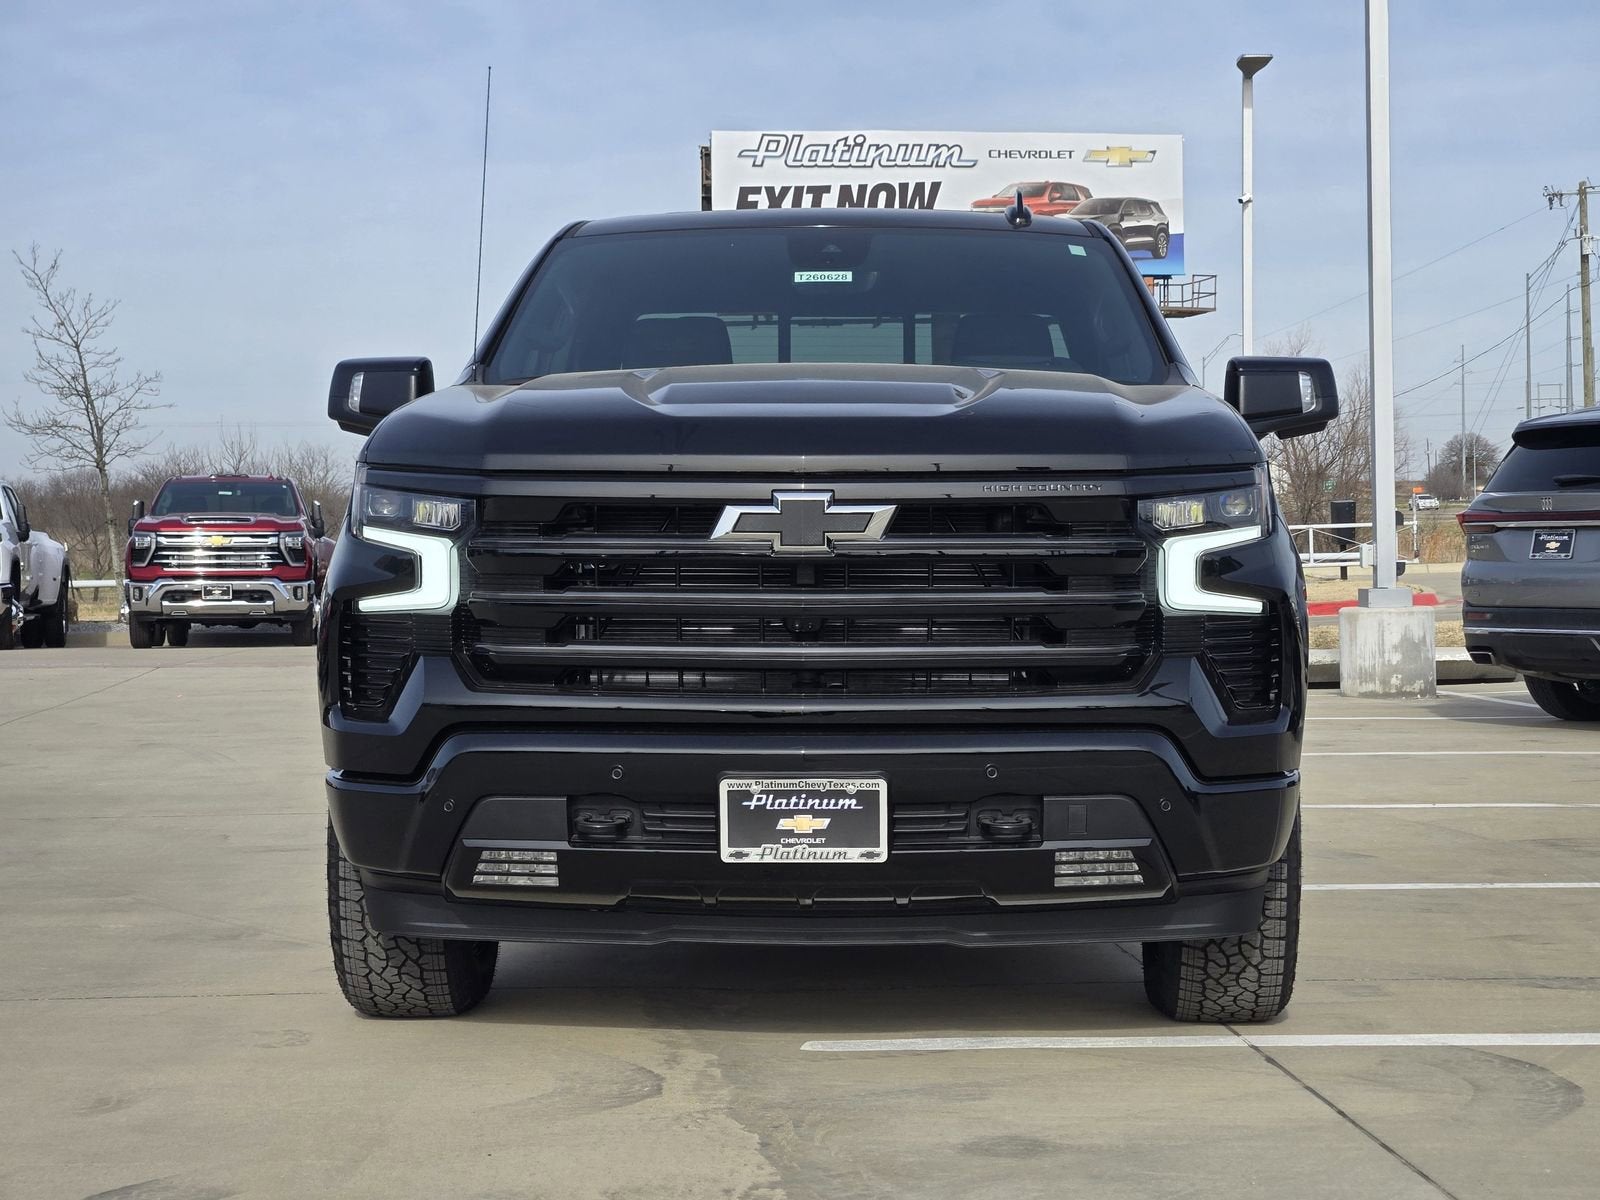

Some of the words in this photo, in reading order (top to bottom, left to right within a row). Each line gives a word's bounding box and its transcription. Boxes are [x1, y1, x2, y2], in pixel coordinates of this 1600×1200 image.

[738, 133, 978, 168] Platinum
[988, 149, 1075, 159] CHEVROLET
[736, 185, 832, 210] EXIT
[837, 181, 942, 210] NOW
[798, 273, 848, 281] T260628
[727, 780, 880, 791] wwwPlatinumChevyTexas.com
[742, 793, 863, 810] Platinum
[754, 845, 855, 860] Platinum
